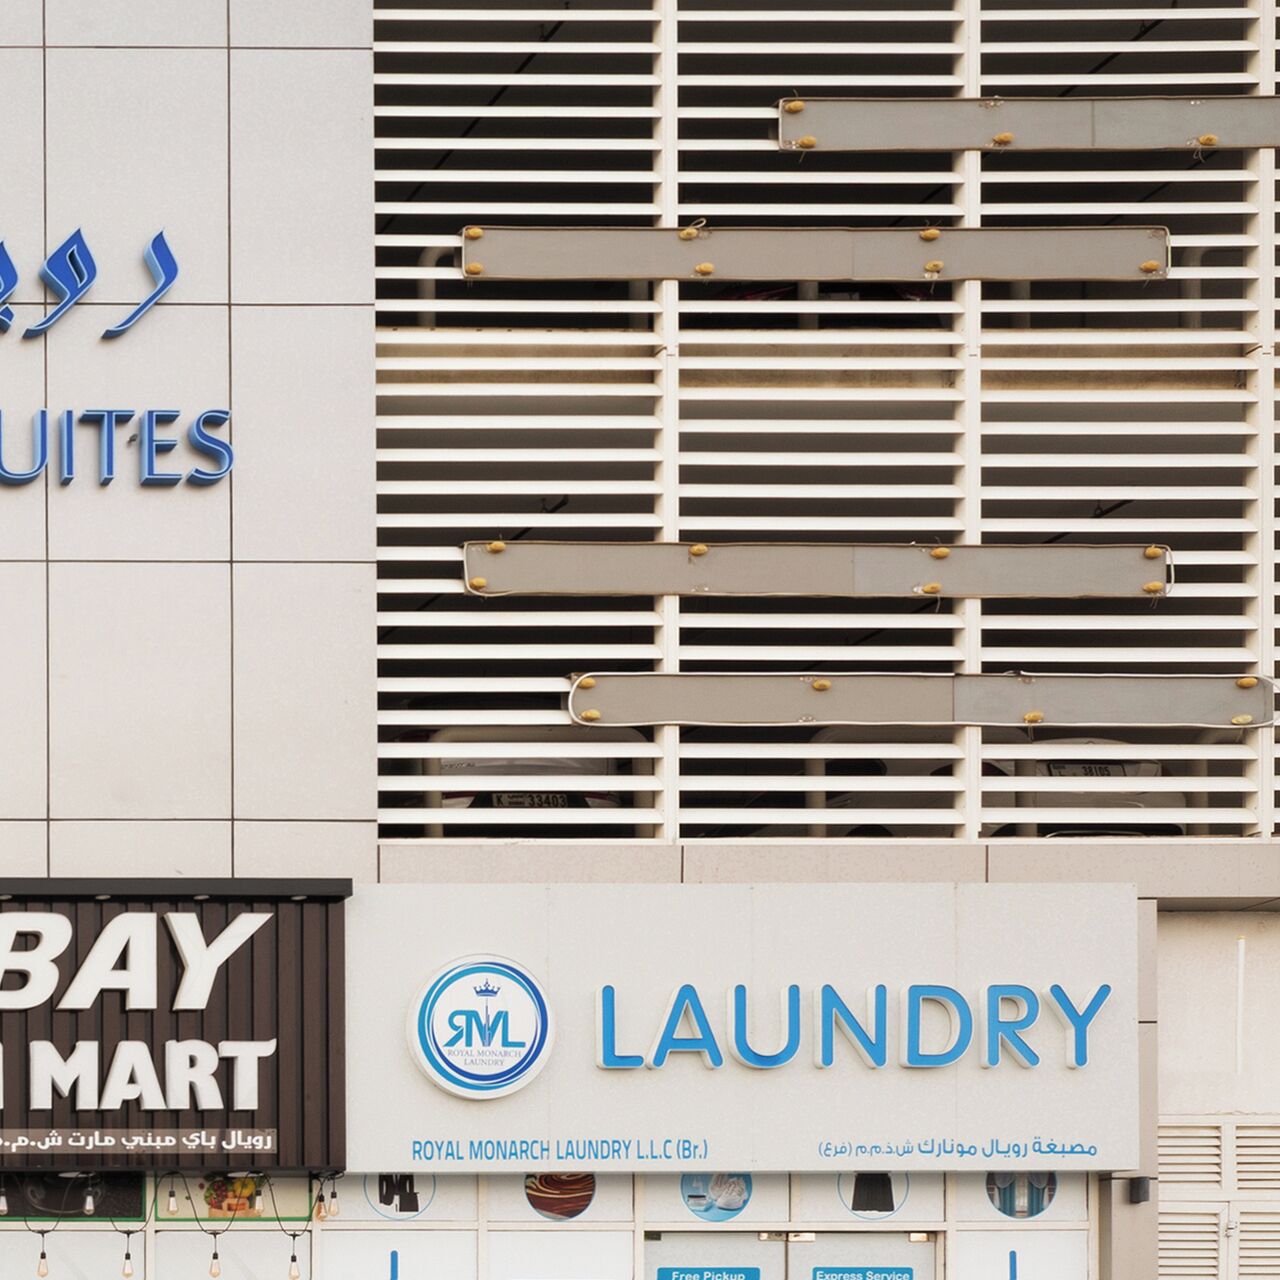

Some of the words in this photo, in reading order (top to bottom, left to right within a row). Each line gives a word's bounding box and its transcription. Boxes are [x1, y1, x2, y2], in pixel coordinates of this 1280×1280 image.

[528, 795, 567, 807] 33403
[598, 983, 1111, 1070] LAUNDRY
[448, 1050, 474, 1058] ROYAL
[477, 1050, 521, 1058] MONARCH
[29, 1038, 277, 1111] MART
[68, 1131, 116, 1149] مارت
[182, 1130, 216, 1150] باي
[221, 1130, 272, 1151] رويال
[412, 1140, 464, 1160] ROYAL
[469, 1140, 550, 1160] MONARCH
[556, 1140, 631, 1160] LAUNDRY
[637, 1139, 672, 1159] L.L.C
[676, 1139, 708, 1160] (Br.)
[818, 1141, 852, 1157] (فرع)
[918, 1138, 977, 1157] مونارك
[982, 1139, 1028, 1158] رويال
[1032, 1136, 1097, 1157] مصبغة
